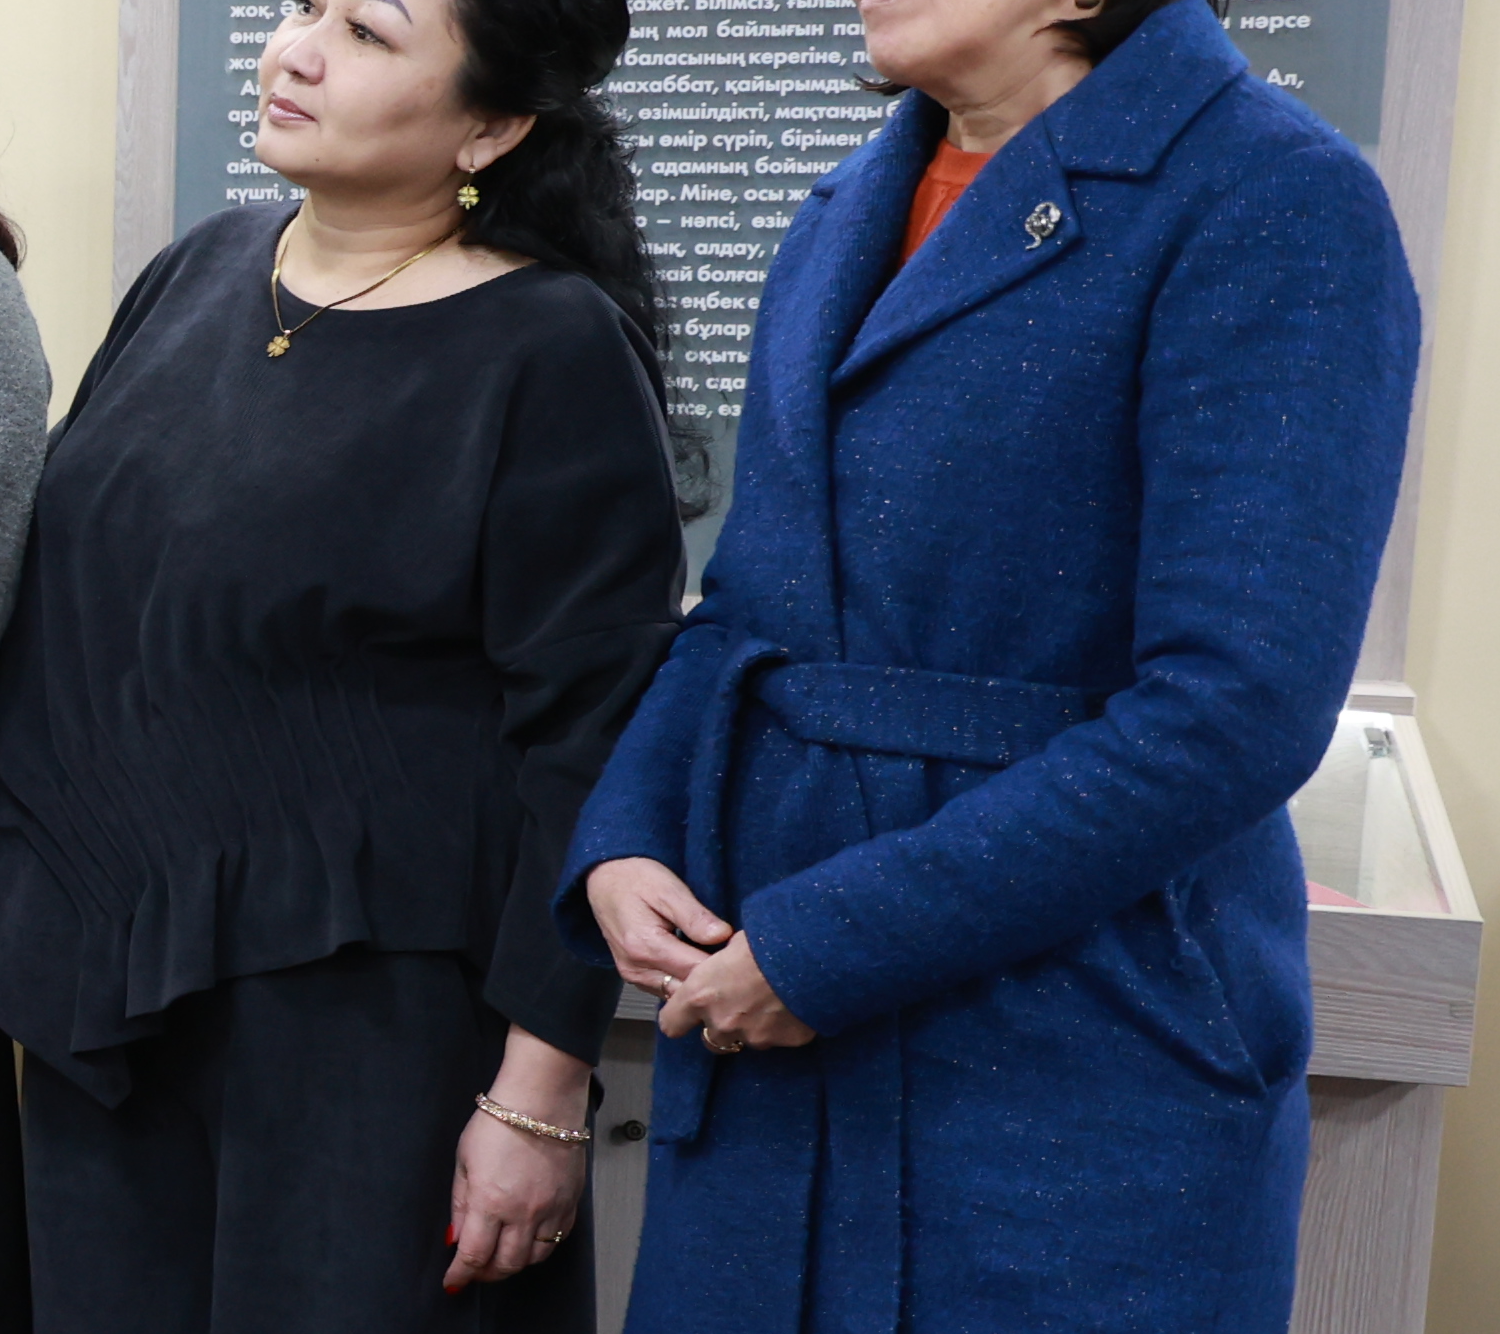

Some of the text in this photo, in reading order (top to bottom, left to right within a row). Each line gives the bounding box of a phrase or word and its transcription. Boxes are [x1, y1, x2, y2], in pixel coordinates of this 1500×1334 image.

[231, 5, 274, 20] жоқ.
[667, 26, 707, 38] мол
[717, 20, 824, 37] байлығын
[1241, 15, 1310, 34] нәрсе
[625, 47, 846, 68] баласының керегіне,
[608, 69, 1303, 96] махаббат, қайырымды Ал,
[639, 102, 883, 122] өзімшілдікті, мақтанды
[659, 128, 862, 152] өмір сүріп, бірімен
[652, 161, 748, 176] адамның
[227, 183, 284, 204] күшті,
[680, 183, 737, 203] Міне,
[744, 189, 783, 202] осы
[681, 211, 740, 231] нәпсі,
[695, 242, 765, 260] алдау,
[681, 291, 745, 310] еңбек
